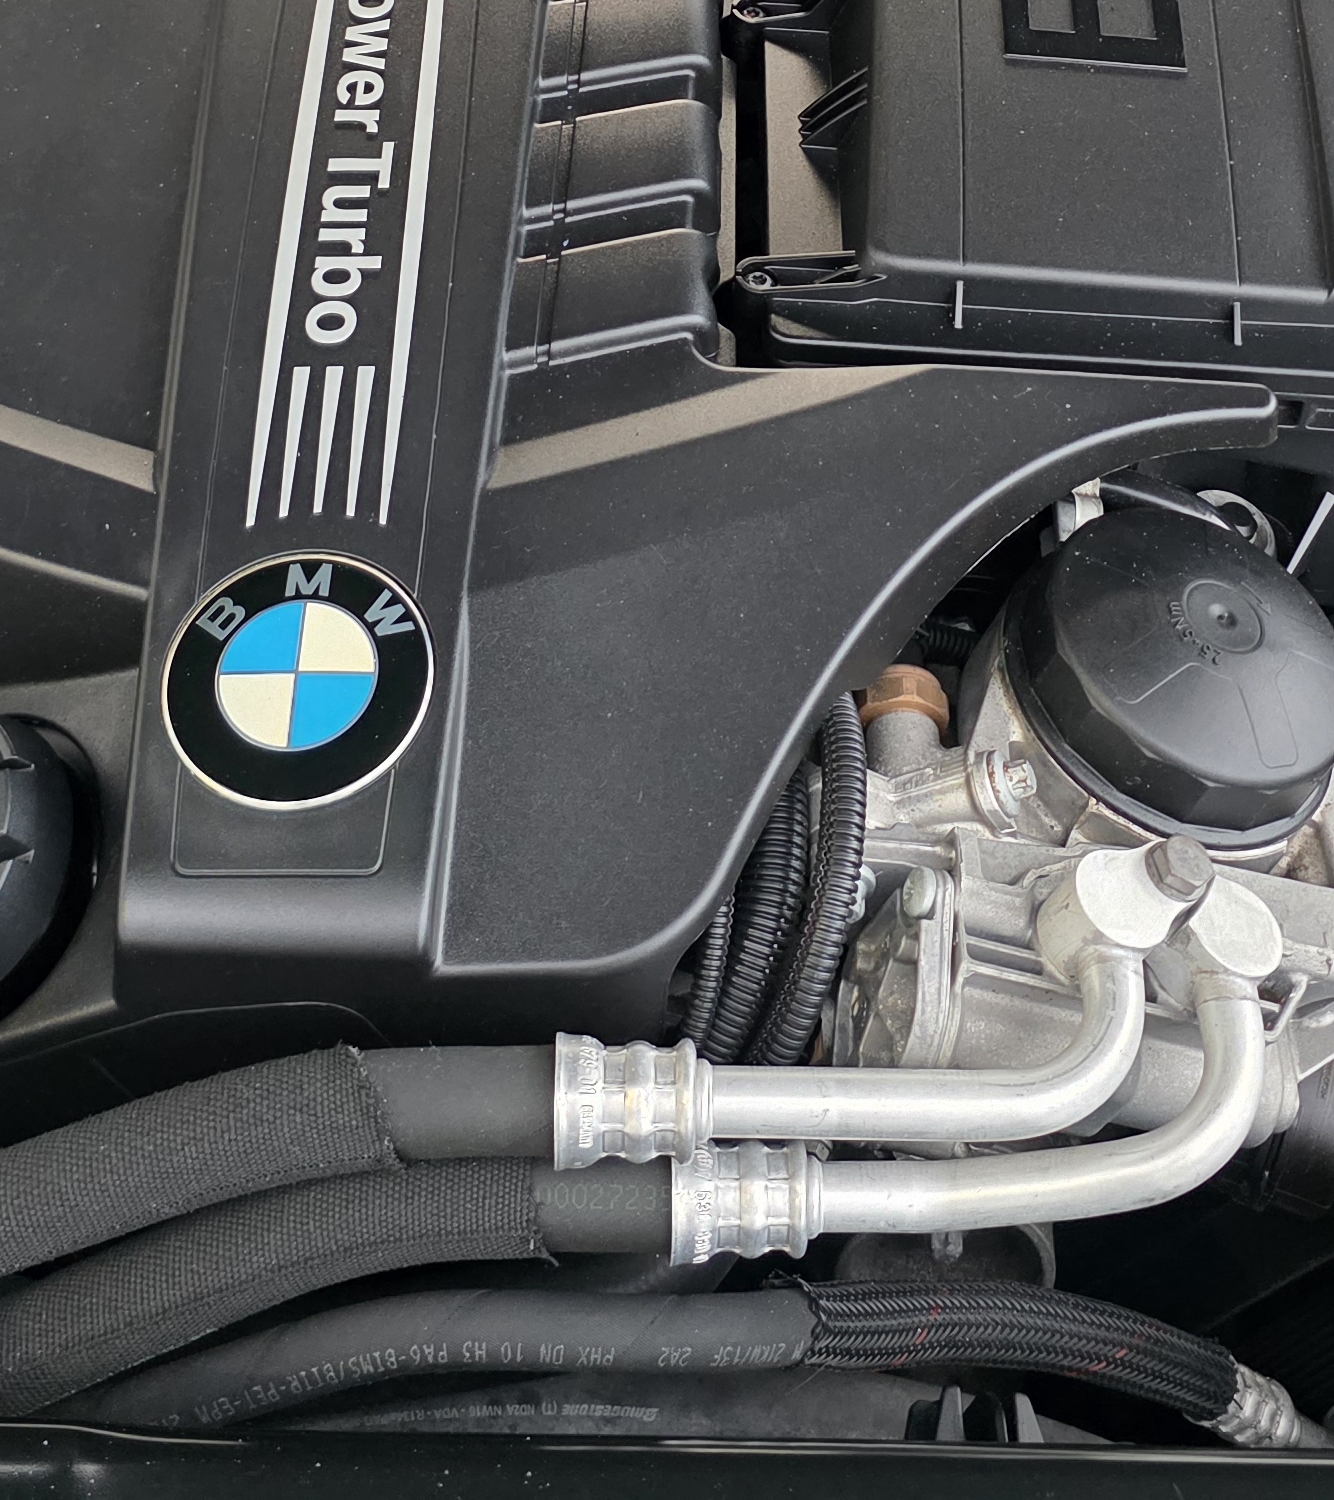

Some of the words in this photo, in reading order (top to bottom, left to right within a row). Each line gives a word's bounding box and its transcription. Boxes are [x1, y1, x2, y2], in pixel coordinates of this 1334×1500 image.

[305, 142, 395, 346] Turbo
[196, 562, 416, 641] BMW
[463, 1341, 487, 1363] H3
[501, 1341, 524, 1363] 10
[539, 1344, 565, 1365] DN
[576, 1345, 617, 1367] PHX
[657, 1346, 692, 1367] 2A2
[507, 1404, 535, 1416] ND2A
